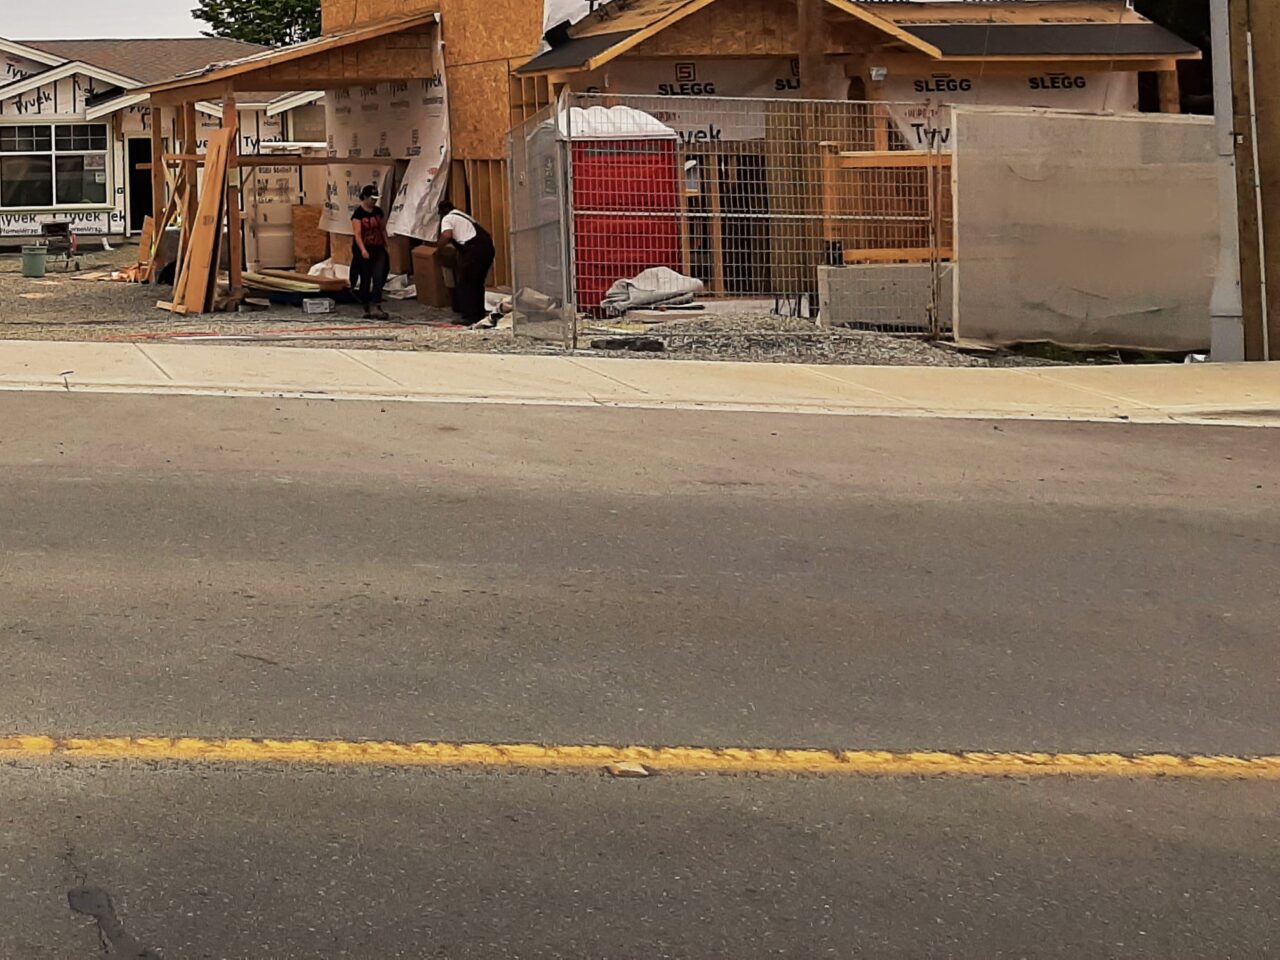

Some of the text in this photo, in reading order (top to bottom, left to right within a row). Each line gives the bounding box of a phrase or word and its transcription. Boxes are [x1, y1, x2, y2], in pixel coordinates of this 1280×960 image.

[658, 83, 716, 95] SLEGG
[913, 79, 971, 92] SLEGG
[1028, 76, 1086, 89] SLEGG
[677, 124, 721, 144] vek
[911, 123, 951, 149] Tyv
